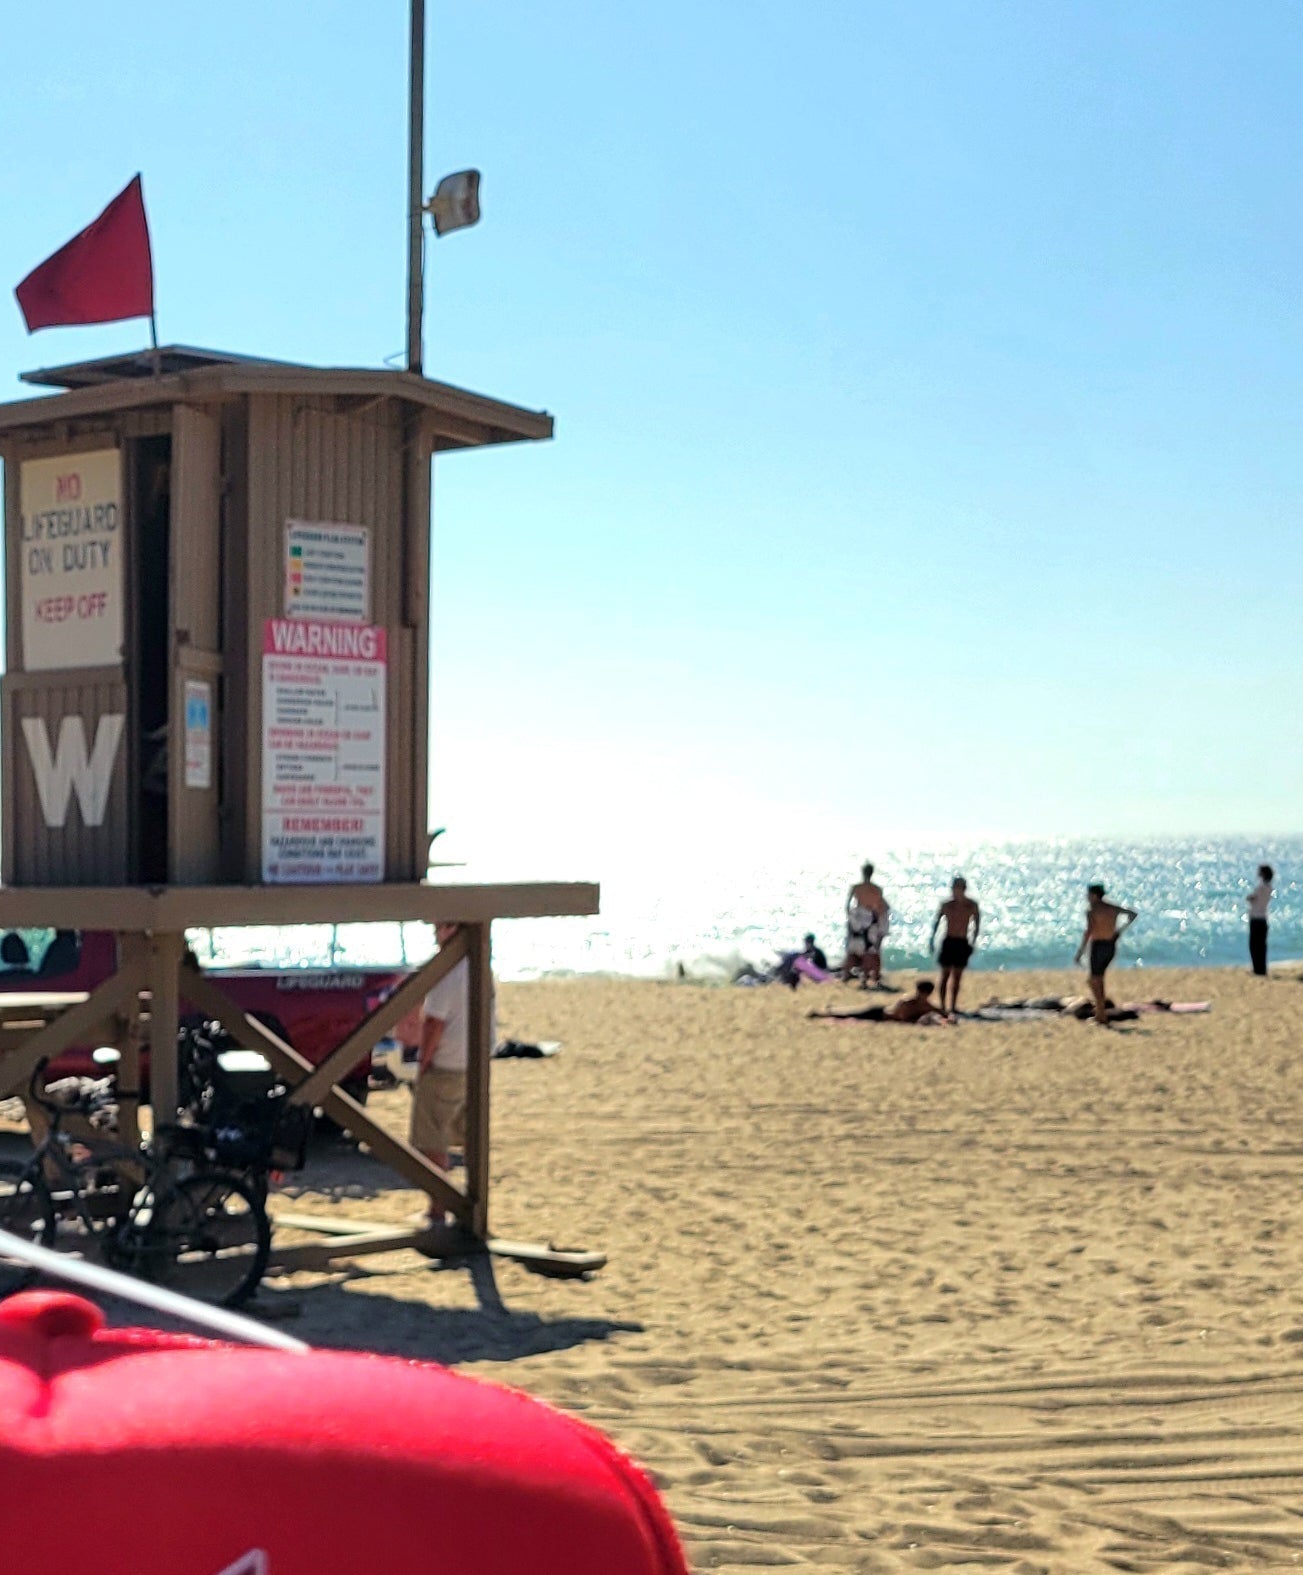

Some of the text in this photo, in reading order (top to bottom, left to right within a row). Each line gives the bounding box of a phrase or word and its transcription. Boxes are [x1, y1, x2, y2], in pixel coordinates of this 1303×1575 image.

[56, 473, 82, 502] NO
[23, 503, 117, 541] LIFEGUARD
[29, 541, 111, 576] ON DUTY
[35, 592, 107, 623] KEEP OFF
[271, 619, 377, 659] WARNING
[21, 714, 126, 827] W
